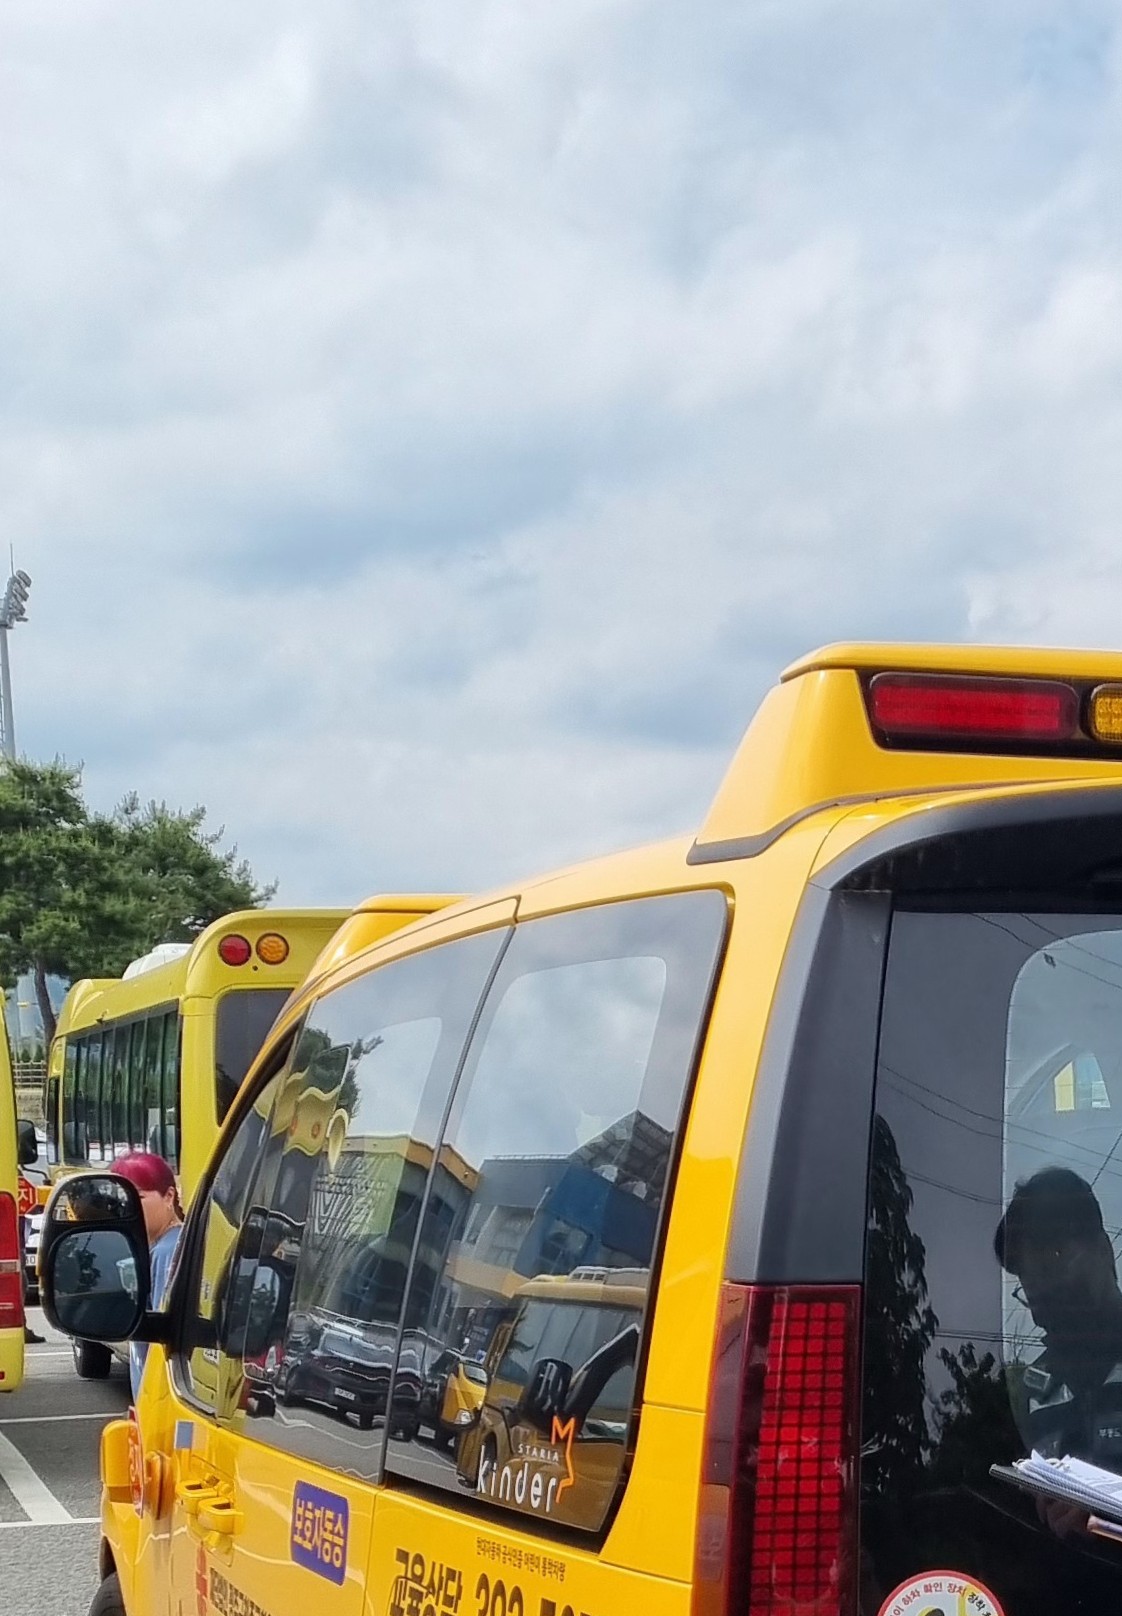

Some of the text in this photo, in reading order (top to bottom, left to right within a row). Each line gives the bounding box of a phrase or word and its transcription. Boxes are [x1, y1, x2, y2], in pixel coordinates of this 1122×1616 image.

[518, 1443, 560, 1461] STARIA
[477, 1445, 557, 1513] kinder
[901, 1589, 921, 1606] 하차
[923, 1582, 943, 1593] 확인
[947, 1583, 967, 1596] 장치
[967, 1592, 986, 1612] 장착
